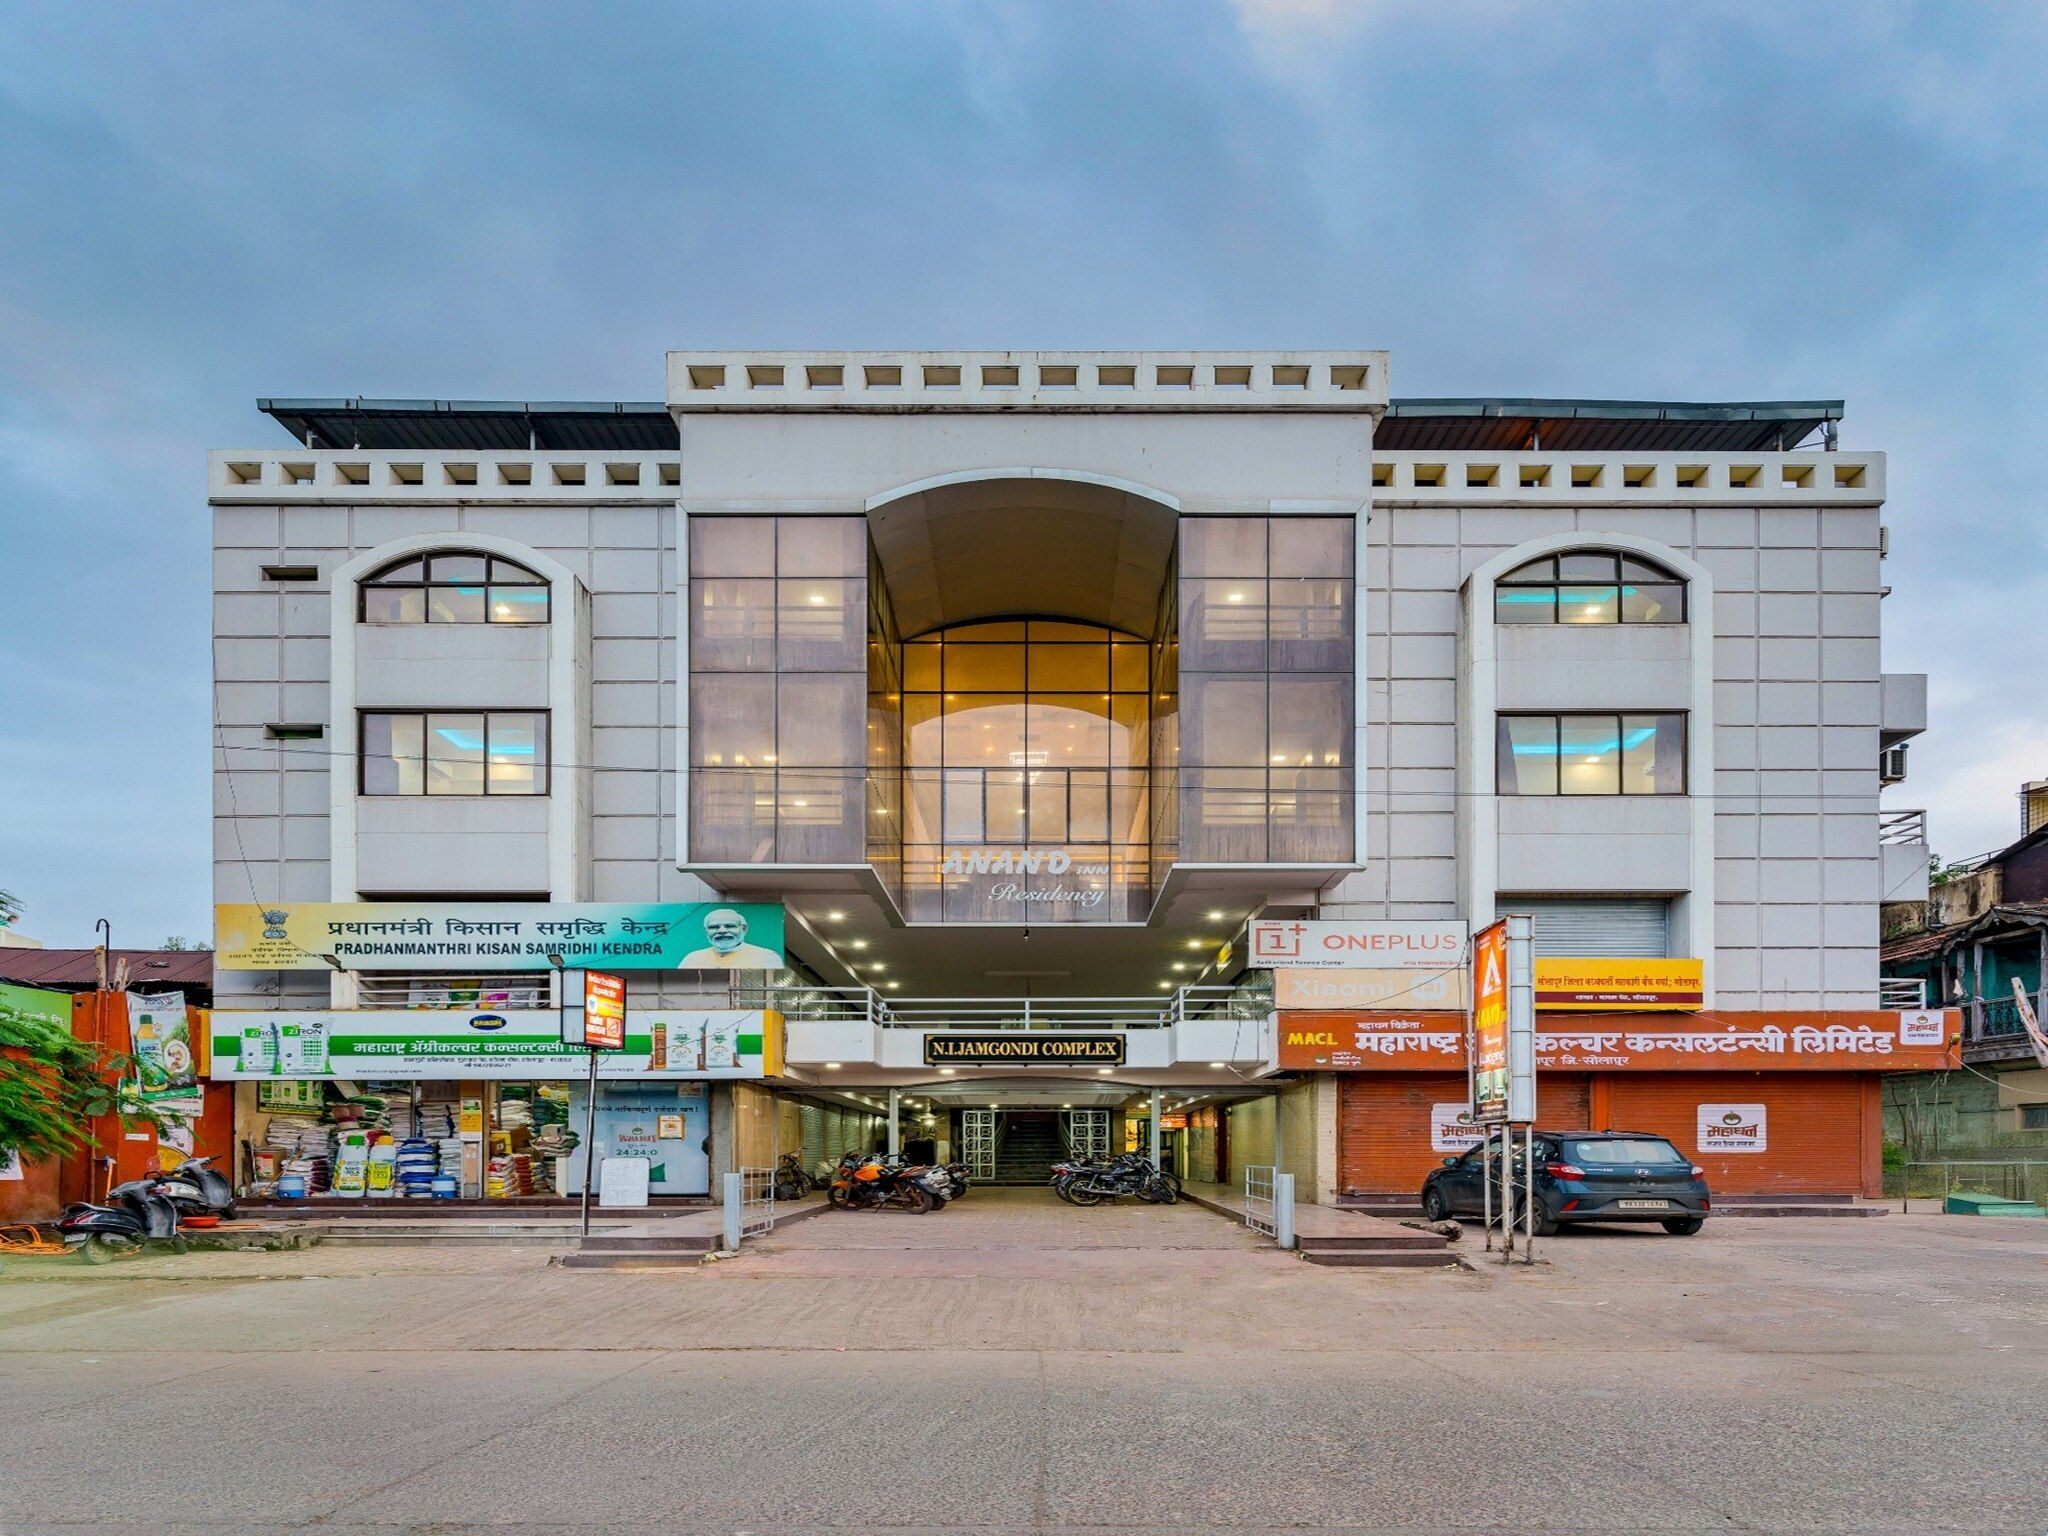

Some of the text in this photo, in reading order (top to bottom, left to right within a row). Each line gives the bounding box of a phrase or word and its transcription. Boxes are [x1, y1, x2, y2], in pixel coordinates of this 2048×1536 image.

[942, 850, 1071, 875] ANAND
[988, 882, 1105, 907] Residency
[328, 917, 670, 939] प्रधानमंत्री किसान समृद्धि केन्द्र
[334, 942, 663, 955] PRADHANMANTHRI KISAN SAMRIDHI KENDRA
[1322, 934, 1457, 950] ONEPLUS
[1291, 979, 1395, 997] Xiaomi
[250, 1030, 274, 1038] ZIRO
[288, 1028, 322, 1036] ZIRON
[1287, 1032, 1338, 1046] MACL
[1354, 1032, 1462, 1055] महाराष्ट्र
[1790, 1025, 1896, 1054] लिमिटेड
[353, 1042, 406, 1055] महाराष्ट्र
[933, 1042, 1116, 1056] N.I.JAMGONDI COMPLEX
[1706, 1123, 1759, 1138] महाधन
